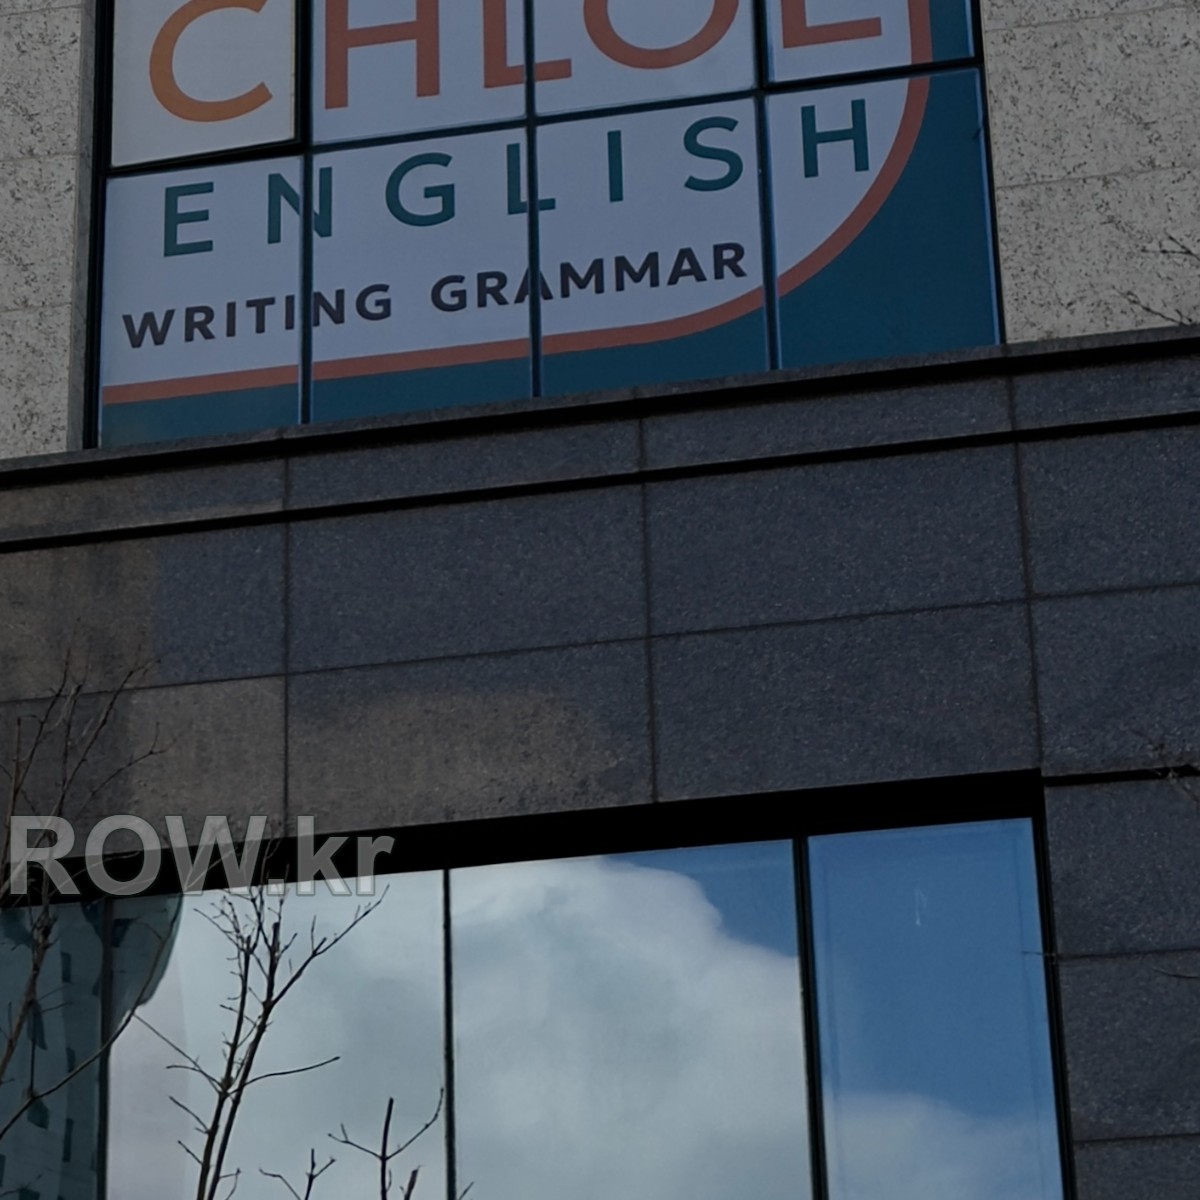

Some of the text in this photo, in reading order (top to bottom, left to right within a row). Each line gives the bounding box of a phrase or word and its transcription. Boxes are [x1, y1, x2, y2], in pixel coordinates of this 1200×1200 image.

[163, 98, 871, 258] ENGLISH
[122, 241, 749, 349] WRITING GRAMMAR
